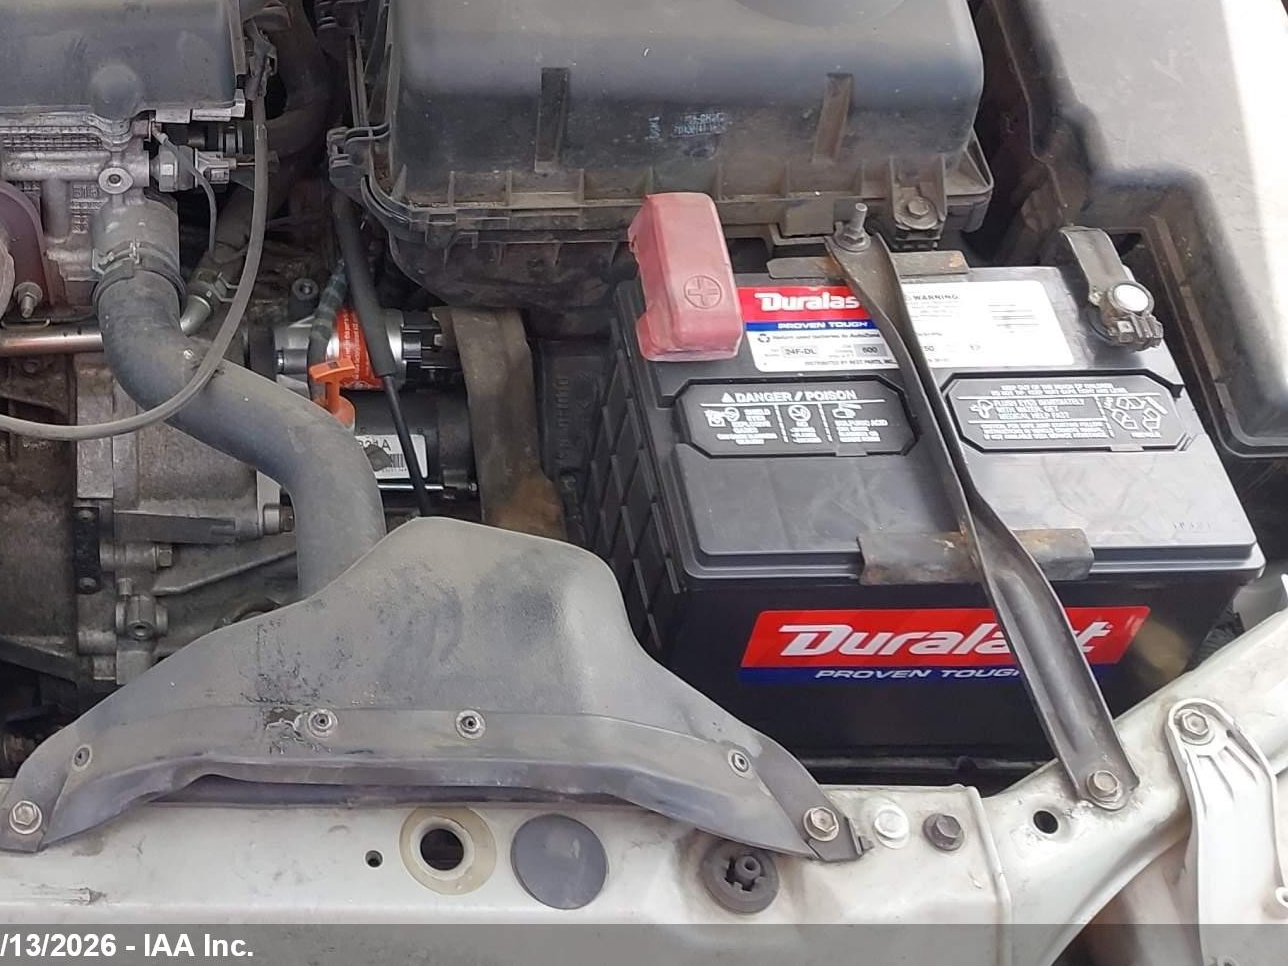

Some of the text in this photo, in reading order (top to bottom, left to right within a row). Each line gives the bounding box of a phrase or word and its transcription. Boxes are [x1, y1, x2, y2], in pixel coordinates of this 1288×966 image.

[754, 291, 861, 312] Duralas
[777, 320, 868, 329] PROVEN TOUGH
[734, 391, 793, 403] DANGER
[804, 389, 858, 401] POISON
[779, 621, 1113, 657] Duralat
[814, 667, 1020, 680] PROVEN TOUG
